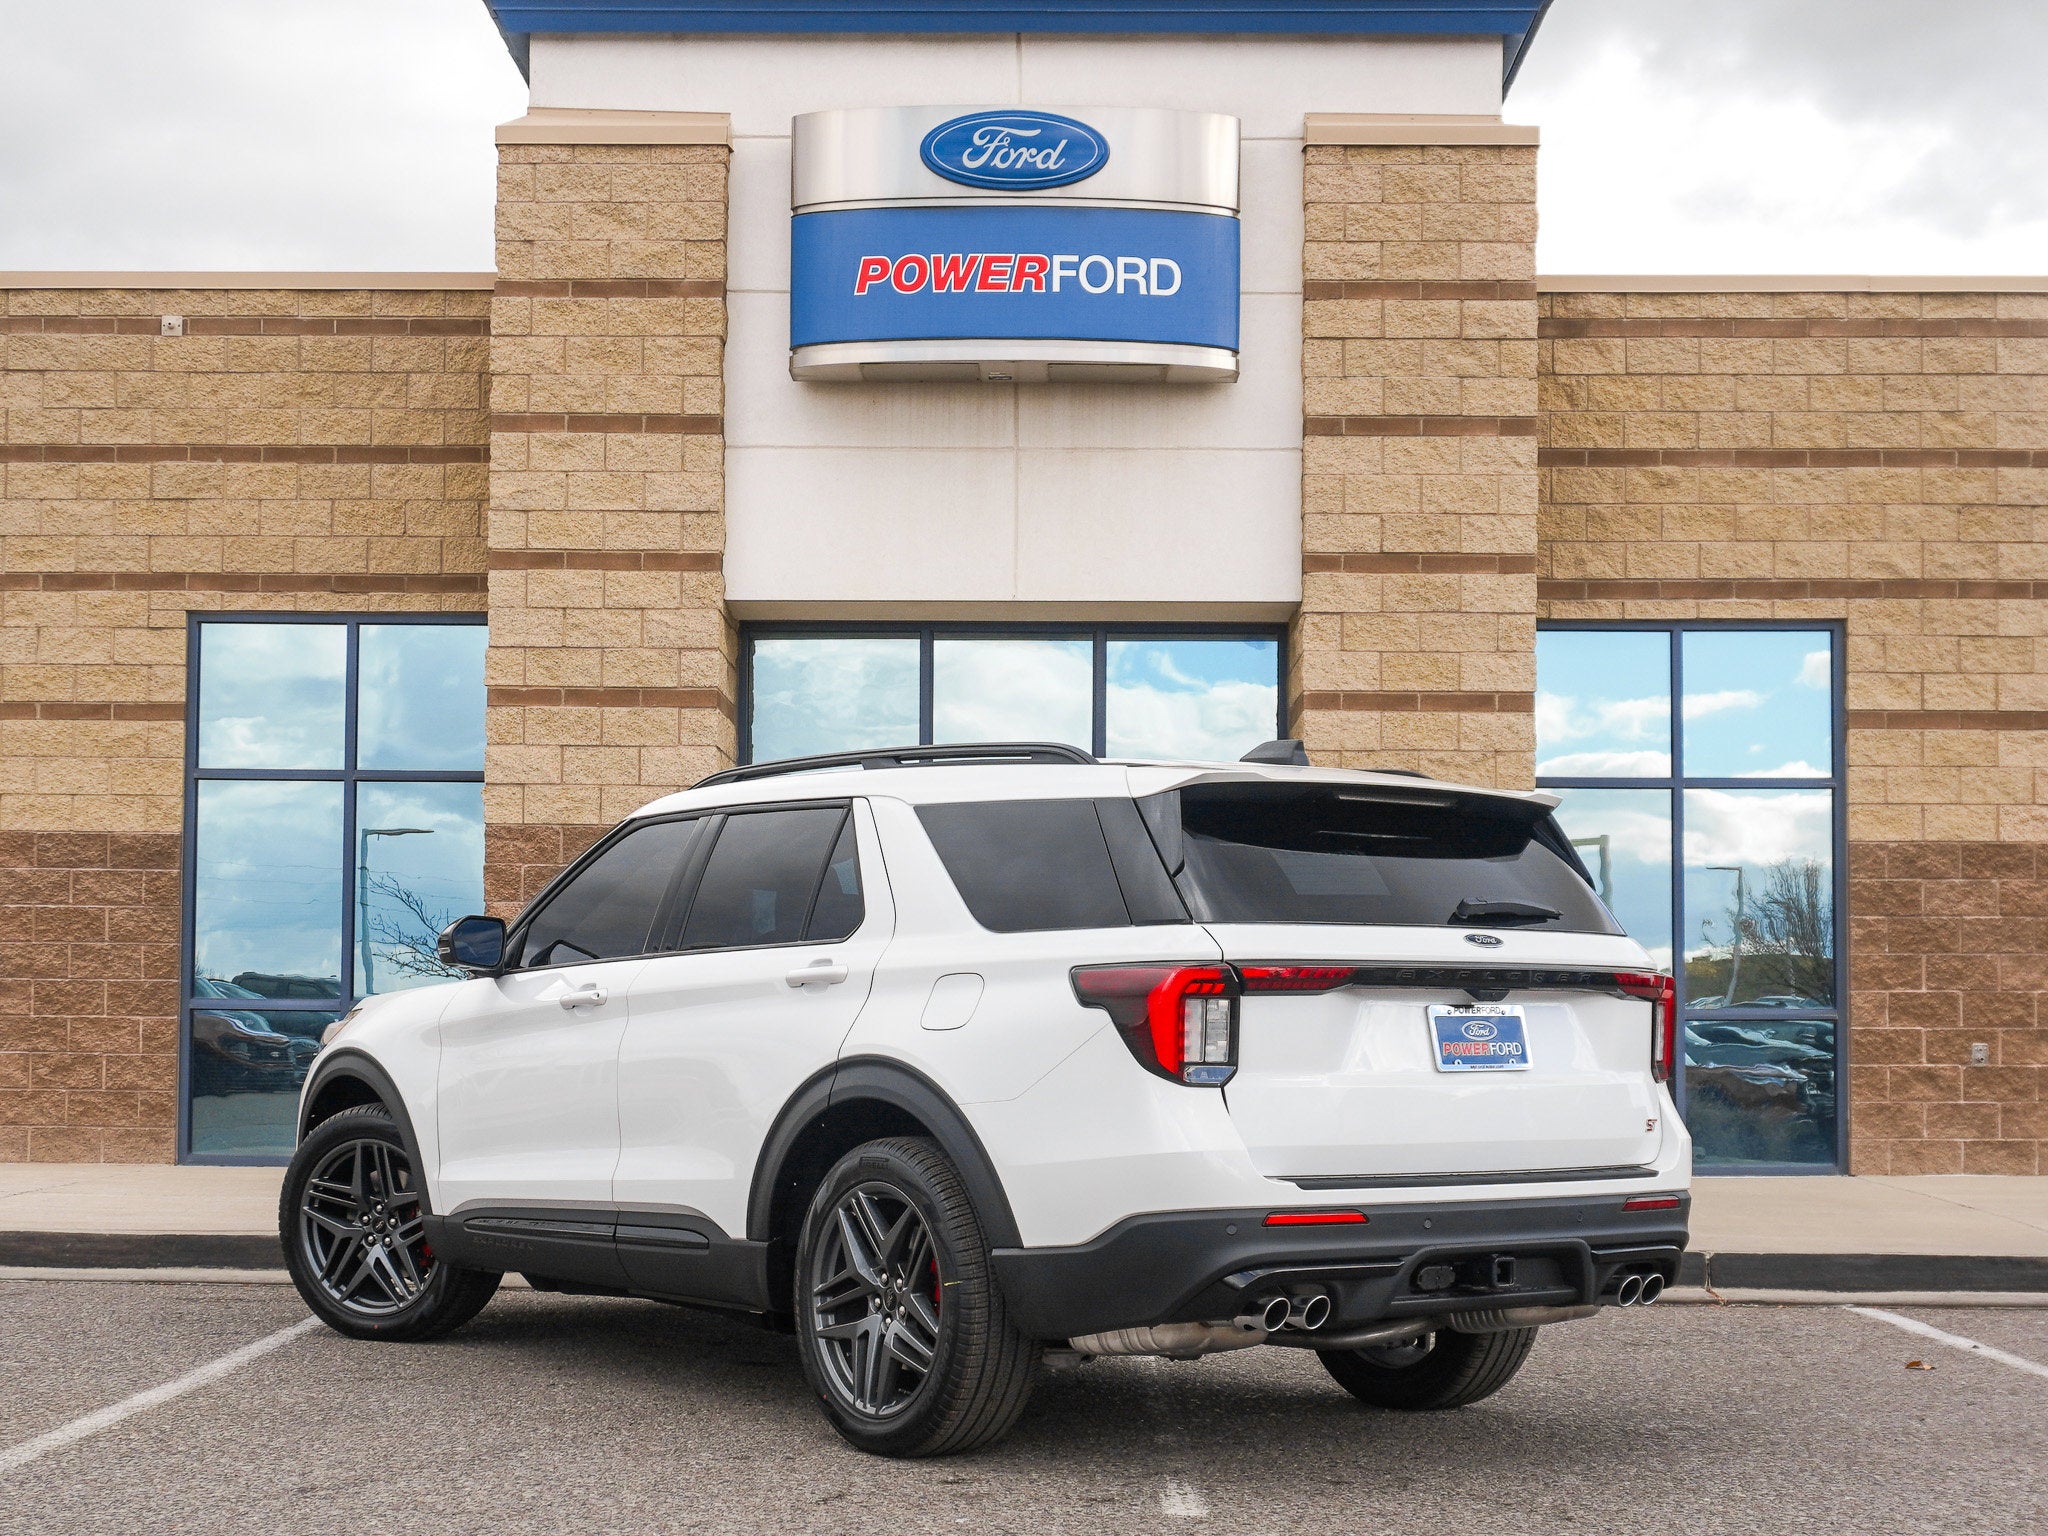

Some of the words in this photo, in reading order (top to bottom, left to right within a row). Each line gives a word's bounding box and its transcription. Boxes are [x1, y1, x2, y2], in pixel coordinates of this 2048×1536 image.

[962, 126, 1066, 170] Ford
[854, 253, 1182, 296] POWERFORD
[1475, 935, 1497, 943] Ford
[1453, 1006, 1501, 1015] POWERFORD
[1468, 1023, 1490, 1036] Ford
[1443, 1042, 1522, 1056] POWERFORD
